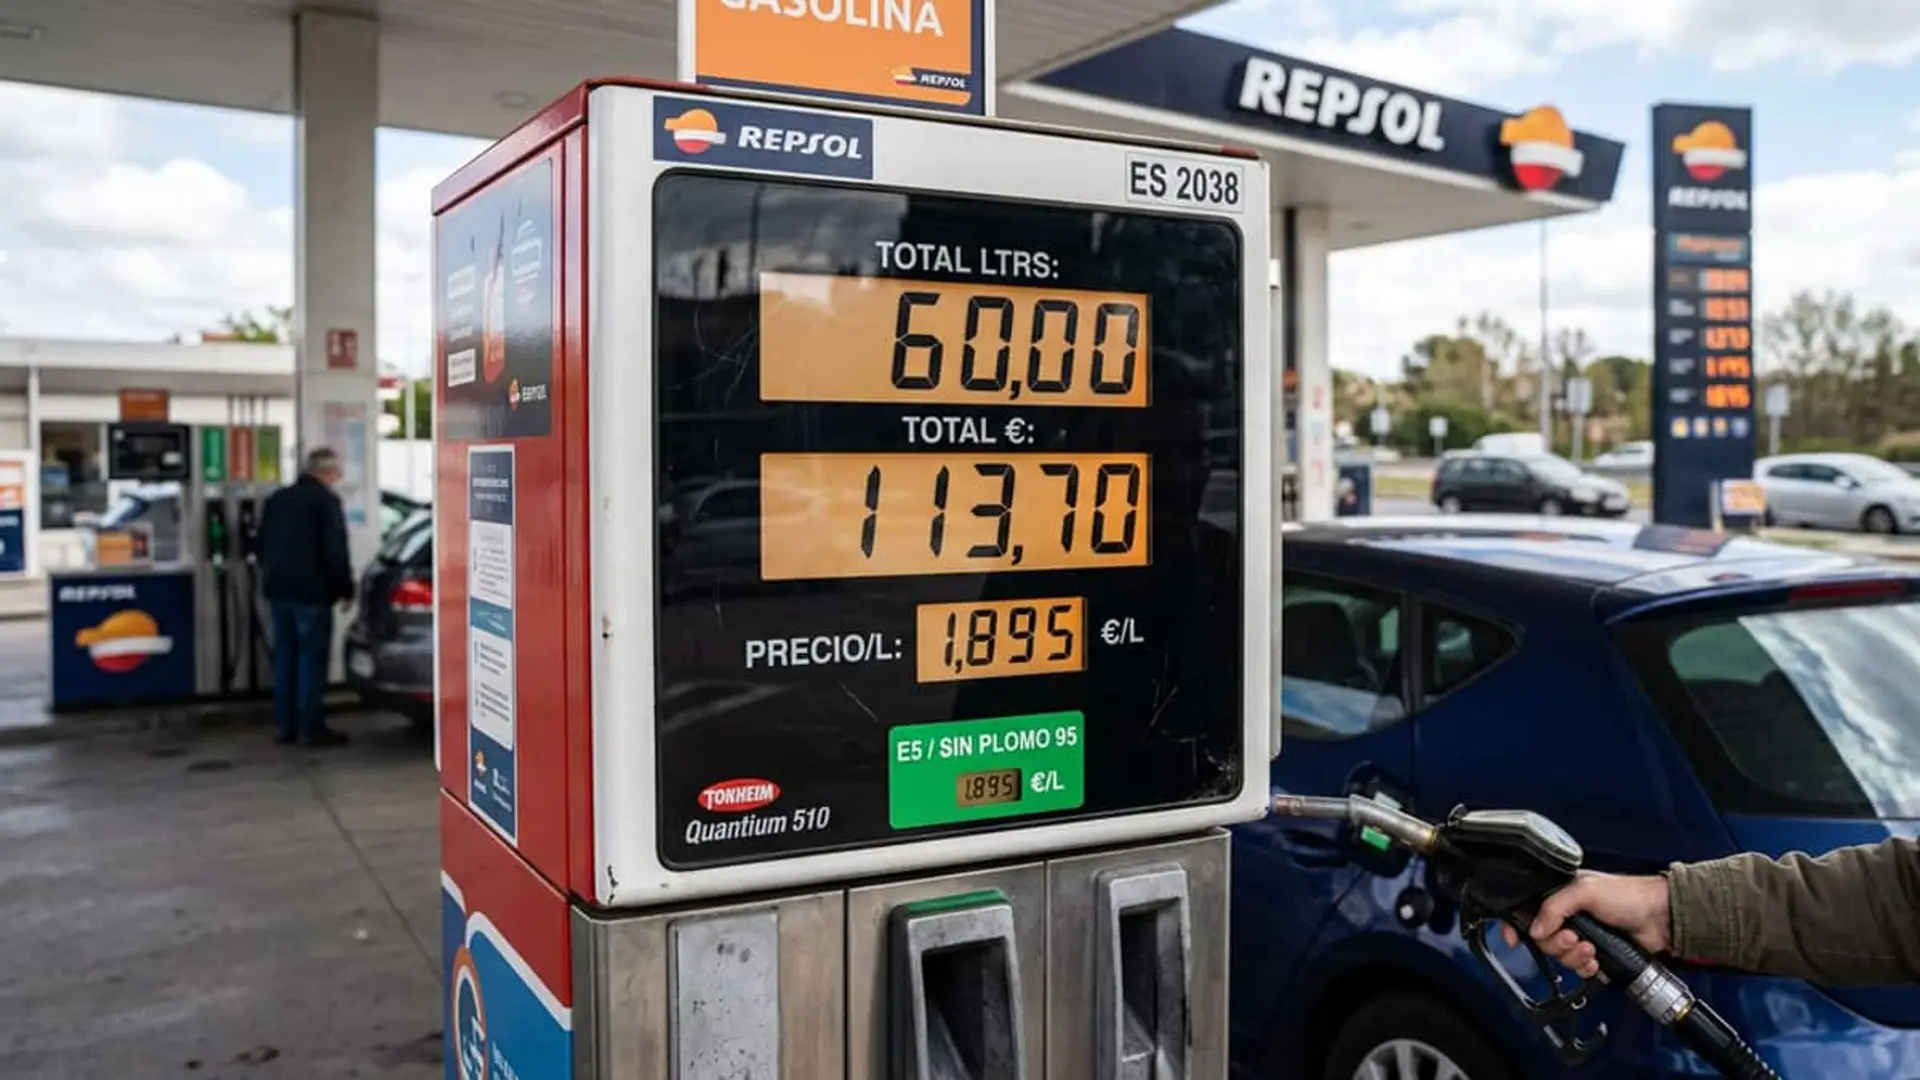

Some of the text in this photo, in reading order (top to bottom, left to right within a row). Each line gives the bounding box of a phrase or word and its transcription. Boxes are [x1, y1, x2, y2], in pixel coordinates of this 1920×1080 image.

[720, 0, 944, 37] SOLINA
[1238, 56, 1445, 152] REPSOL
[738, 125, 862, 160] REPSOL
[1130, 162, 1239, 204] ES 2038
[876, 241, 1060, 279] TOTAL LTRS:
[891, 291, 1140, 400] 60,00
[902, 416, 1035, 445] TOTAL €:
[860, 463, 1140, 565] 113,70
[944, 604, 1073, 674] 1,895
[1101, 618, 1144, 645] €/L
[745, 634, 902, 668] PRECIO/L:
[897, 726, 1077, 762] E5 / SIN PLOMO 95
[1030, 770, 1064, 793] €/L
[685, 806, 831, 845] Quantium 510
